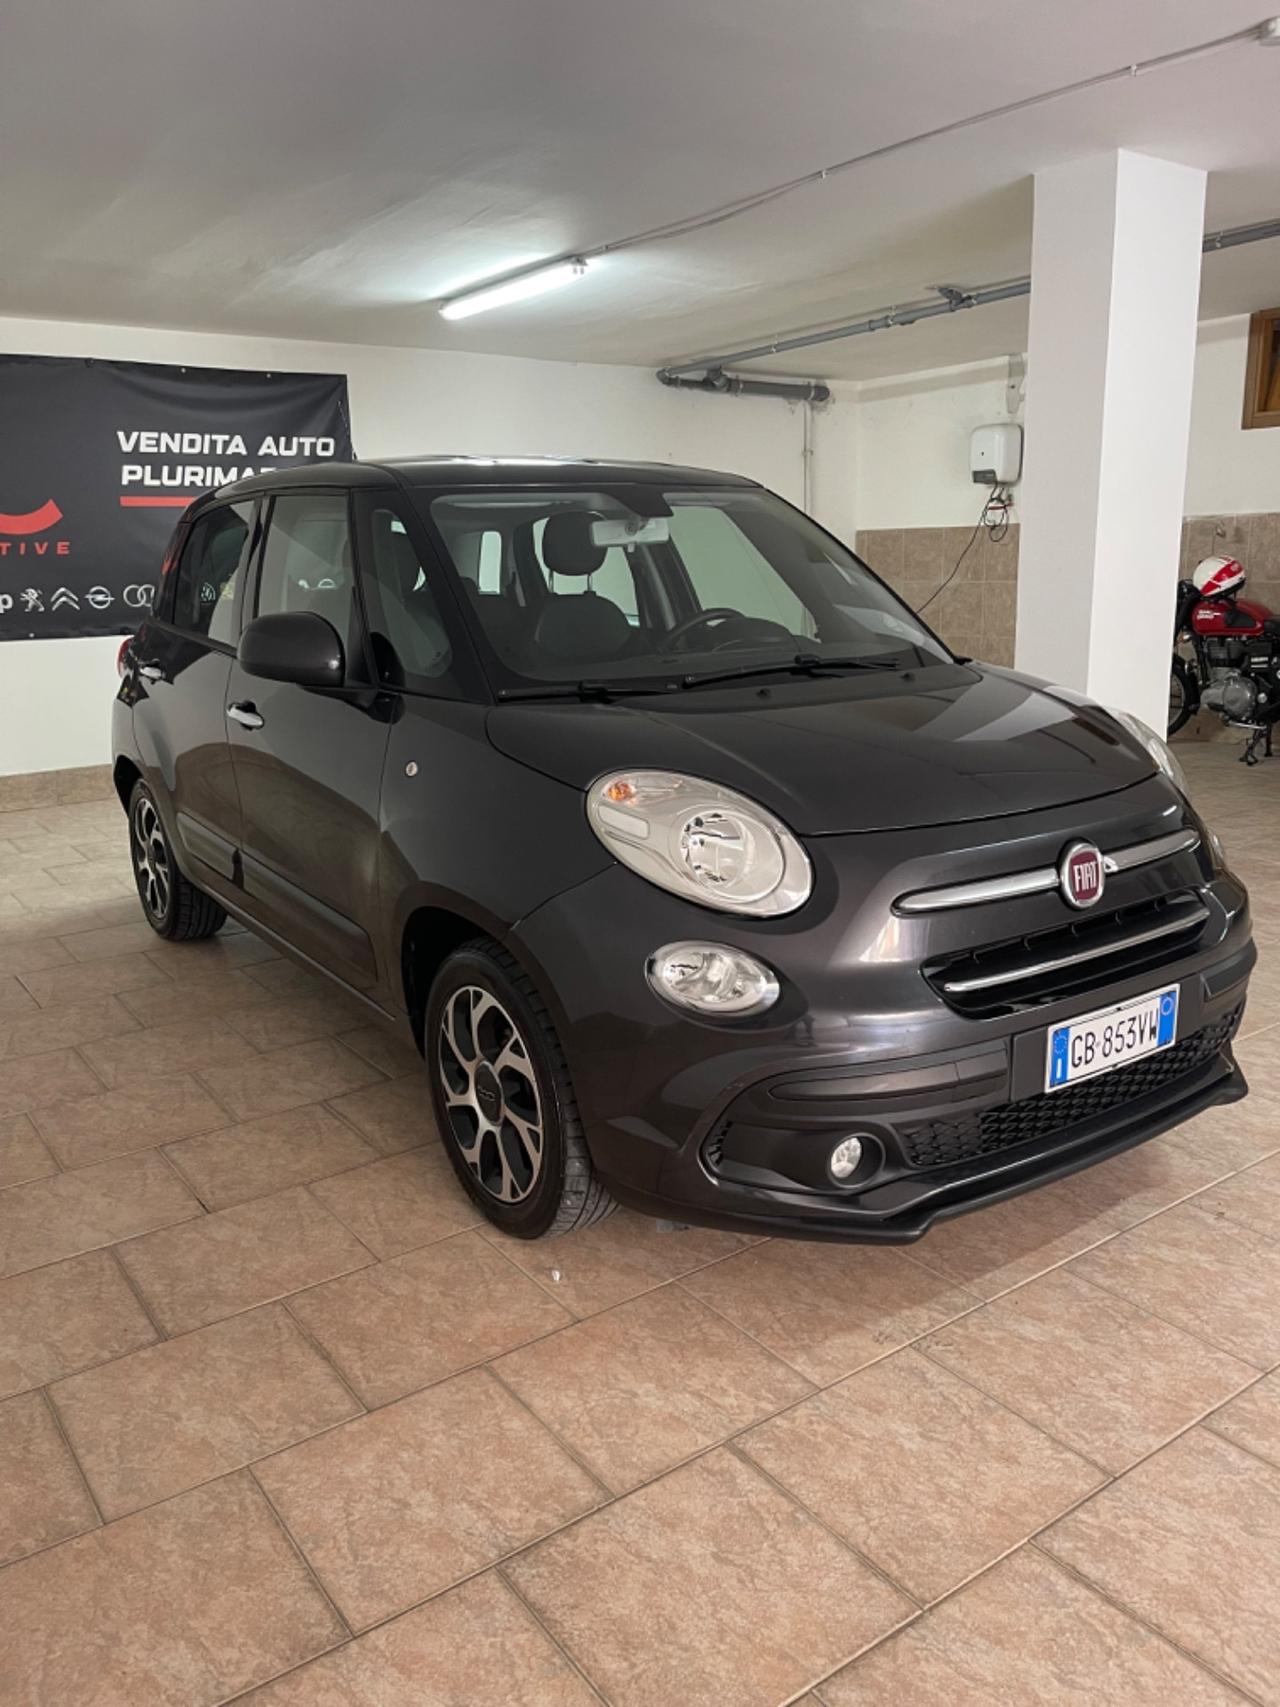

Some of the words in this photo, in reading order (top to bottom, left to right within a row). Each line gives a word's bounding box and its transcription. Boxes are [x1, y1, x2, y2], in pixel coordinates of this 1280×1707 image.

[117, 431, 247, 455] VENDITA
[257, 436, 335, 456] AUTO
[121, 464, 276, 487] PLURIMA
[1073, 861, 1097, 892] FIAT
